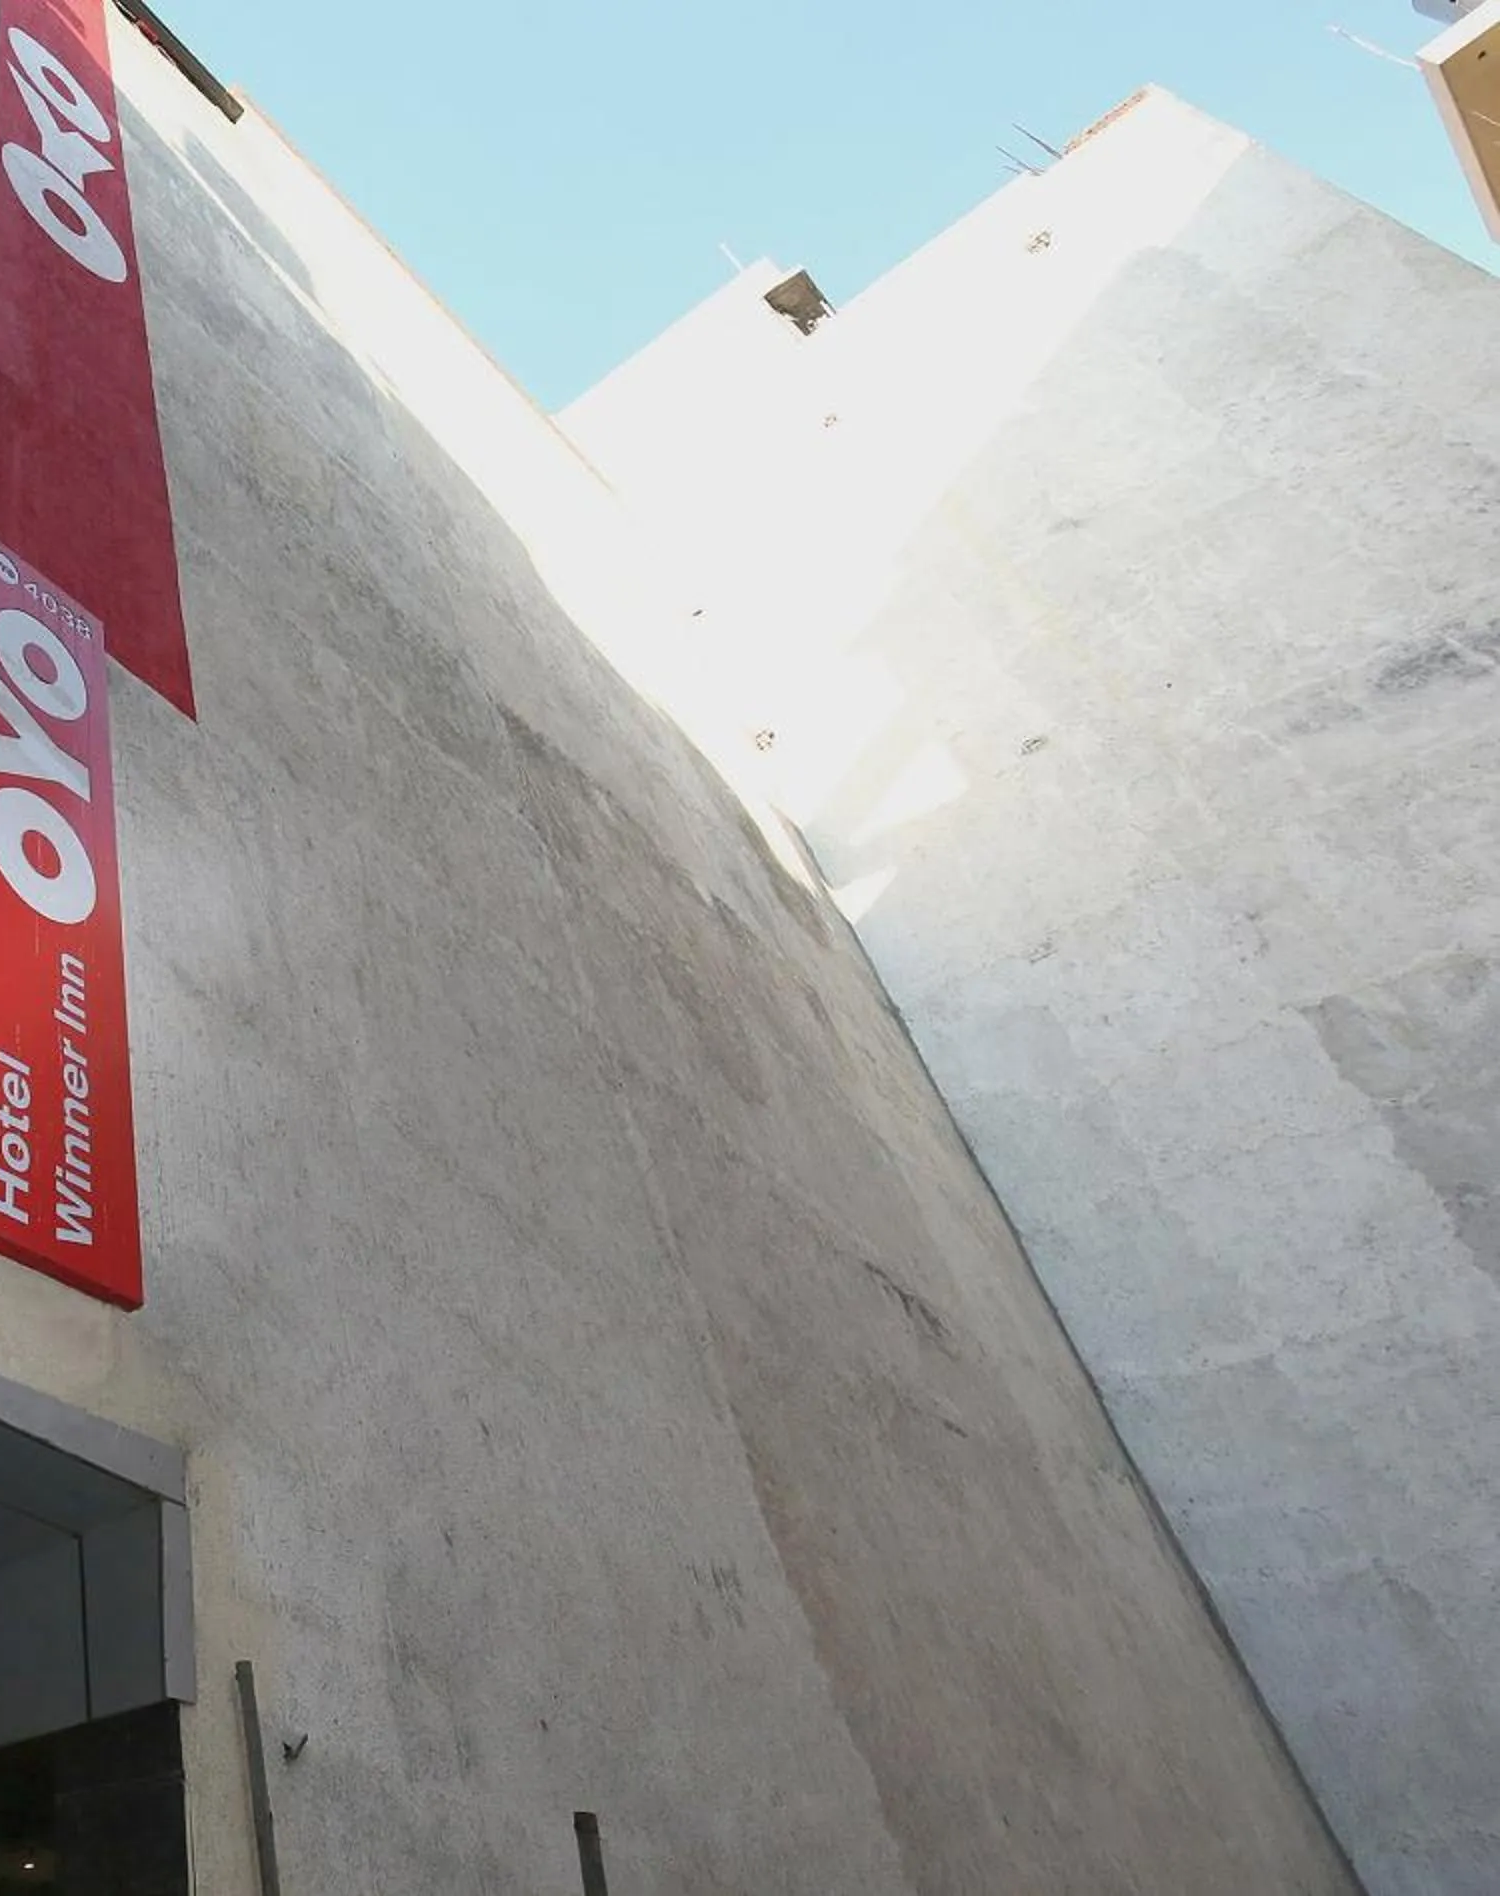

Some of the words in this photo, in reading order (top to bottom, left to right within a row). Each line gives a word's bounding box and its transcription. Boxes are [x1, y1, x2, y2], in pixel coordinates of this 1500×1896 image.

[3, 28, 127, 282] OYO
[54, 953, 86, 1034] Inn
[55, 1038, 94, 1246] Winner
